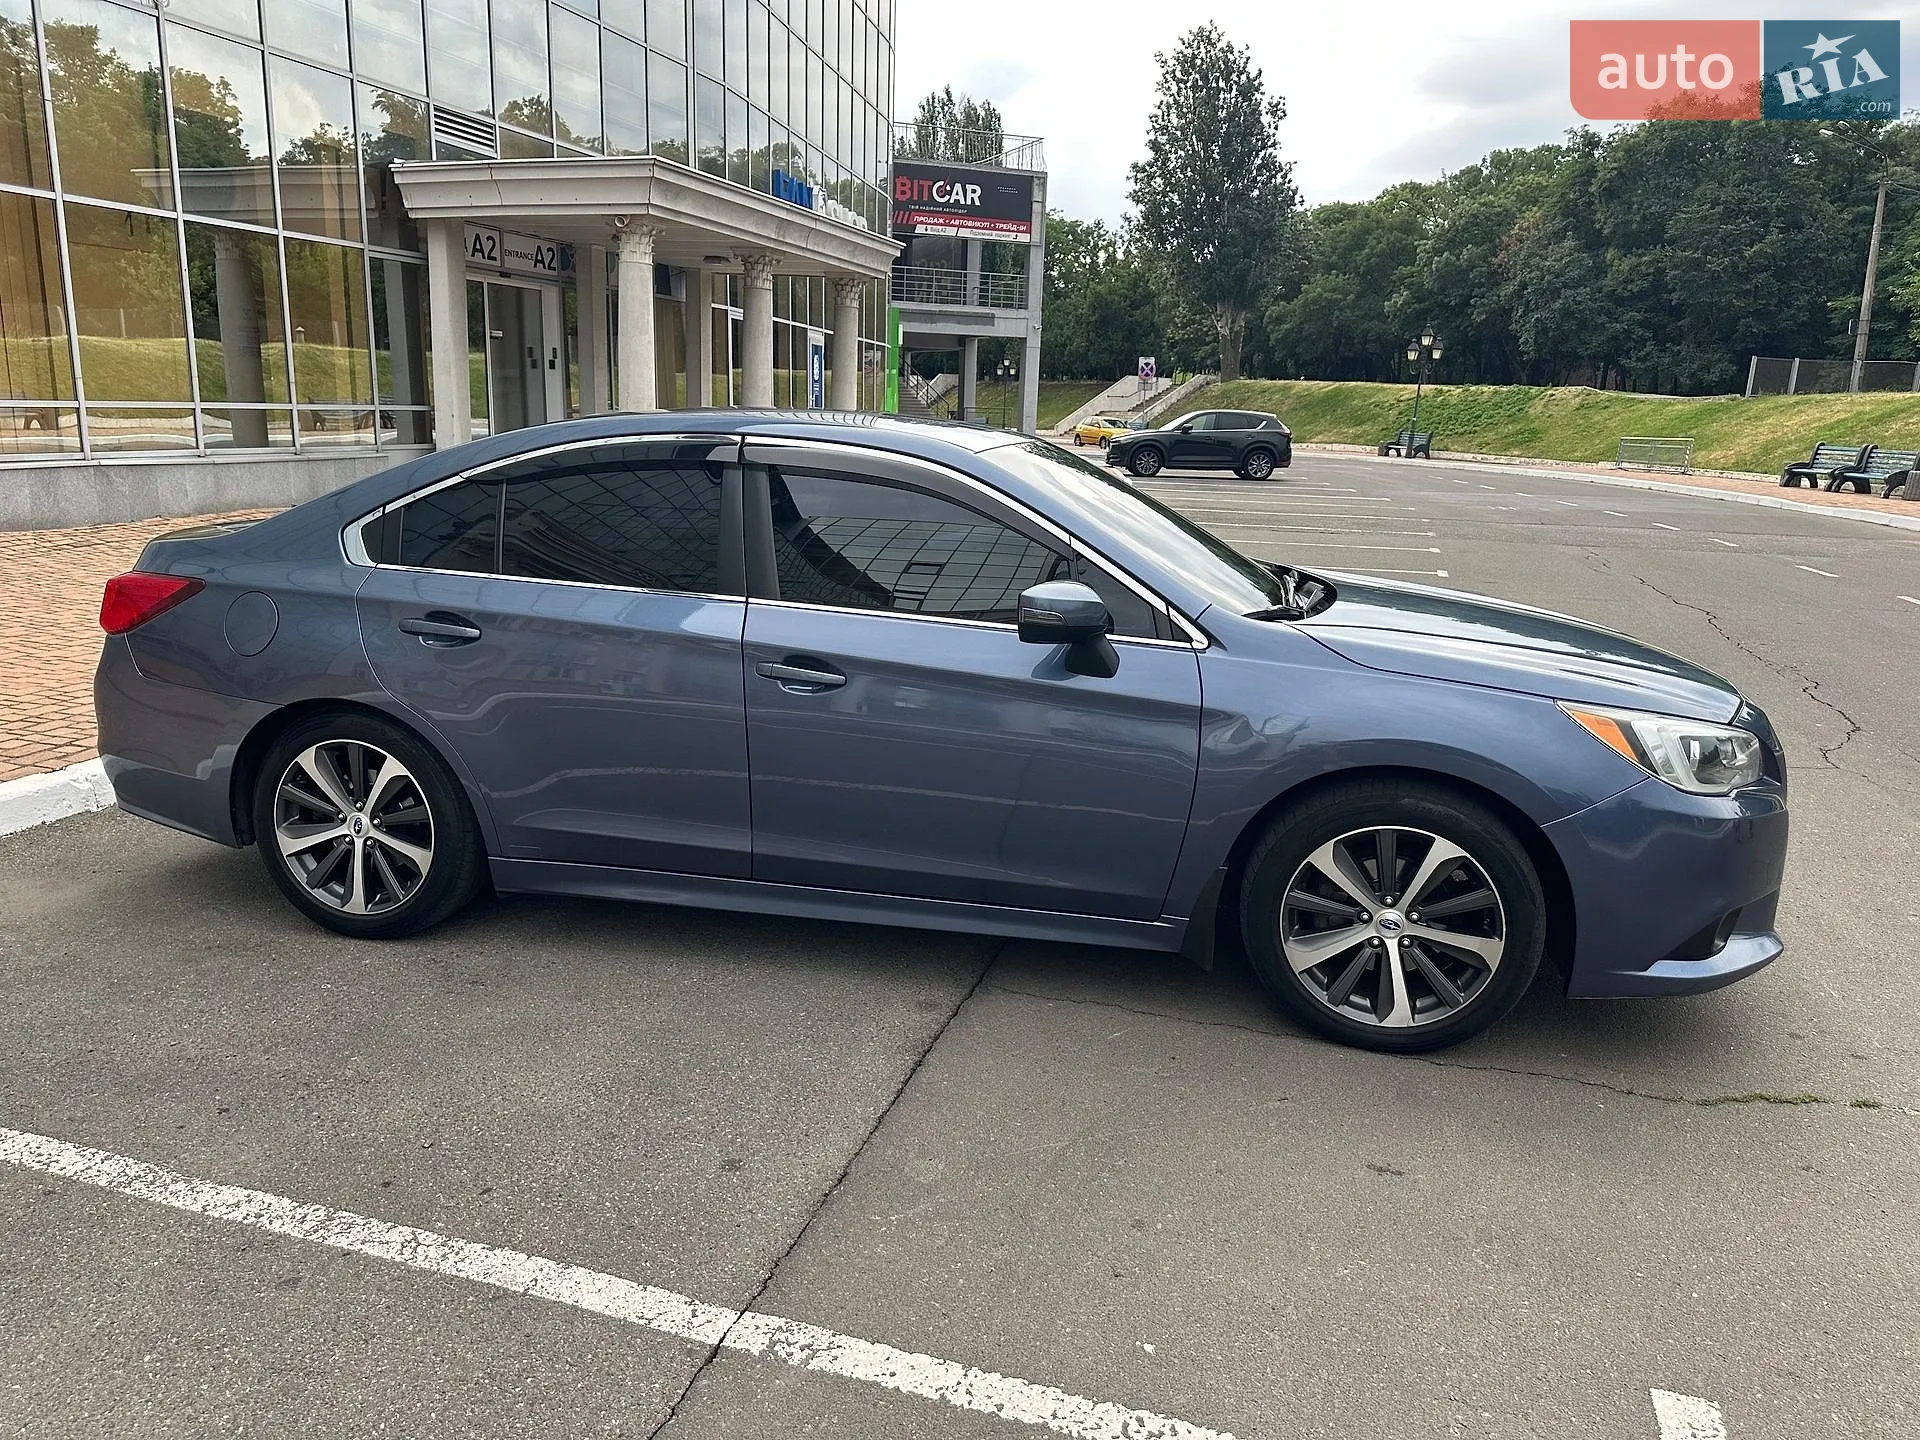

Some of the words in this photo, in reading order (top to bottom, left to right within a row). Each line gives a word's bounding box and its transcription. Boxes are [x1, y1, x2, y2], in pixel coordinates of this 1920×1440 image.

[894, 176, 982, 206] BITCAR
[914, 216, 945, 224] ПРОДАЖ
[949, 219, 990, 229] АВТОВИКУП
[995, 222, 1027, 232] ТРЕЙД-ІН
[471, 233, 498, 262] A2
[505, 249, 534, 261] ENTRANCE
[533, 245, 557, 272] A2
